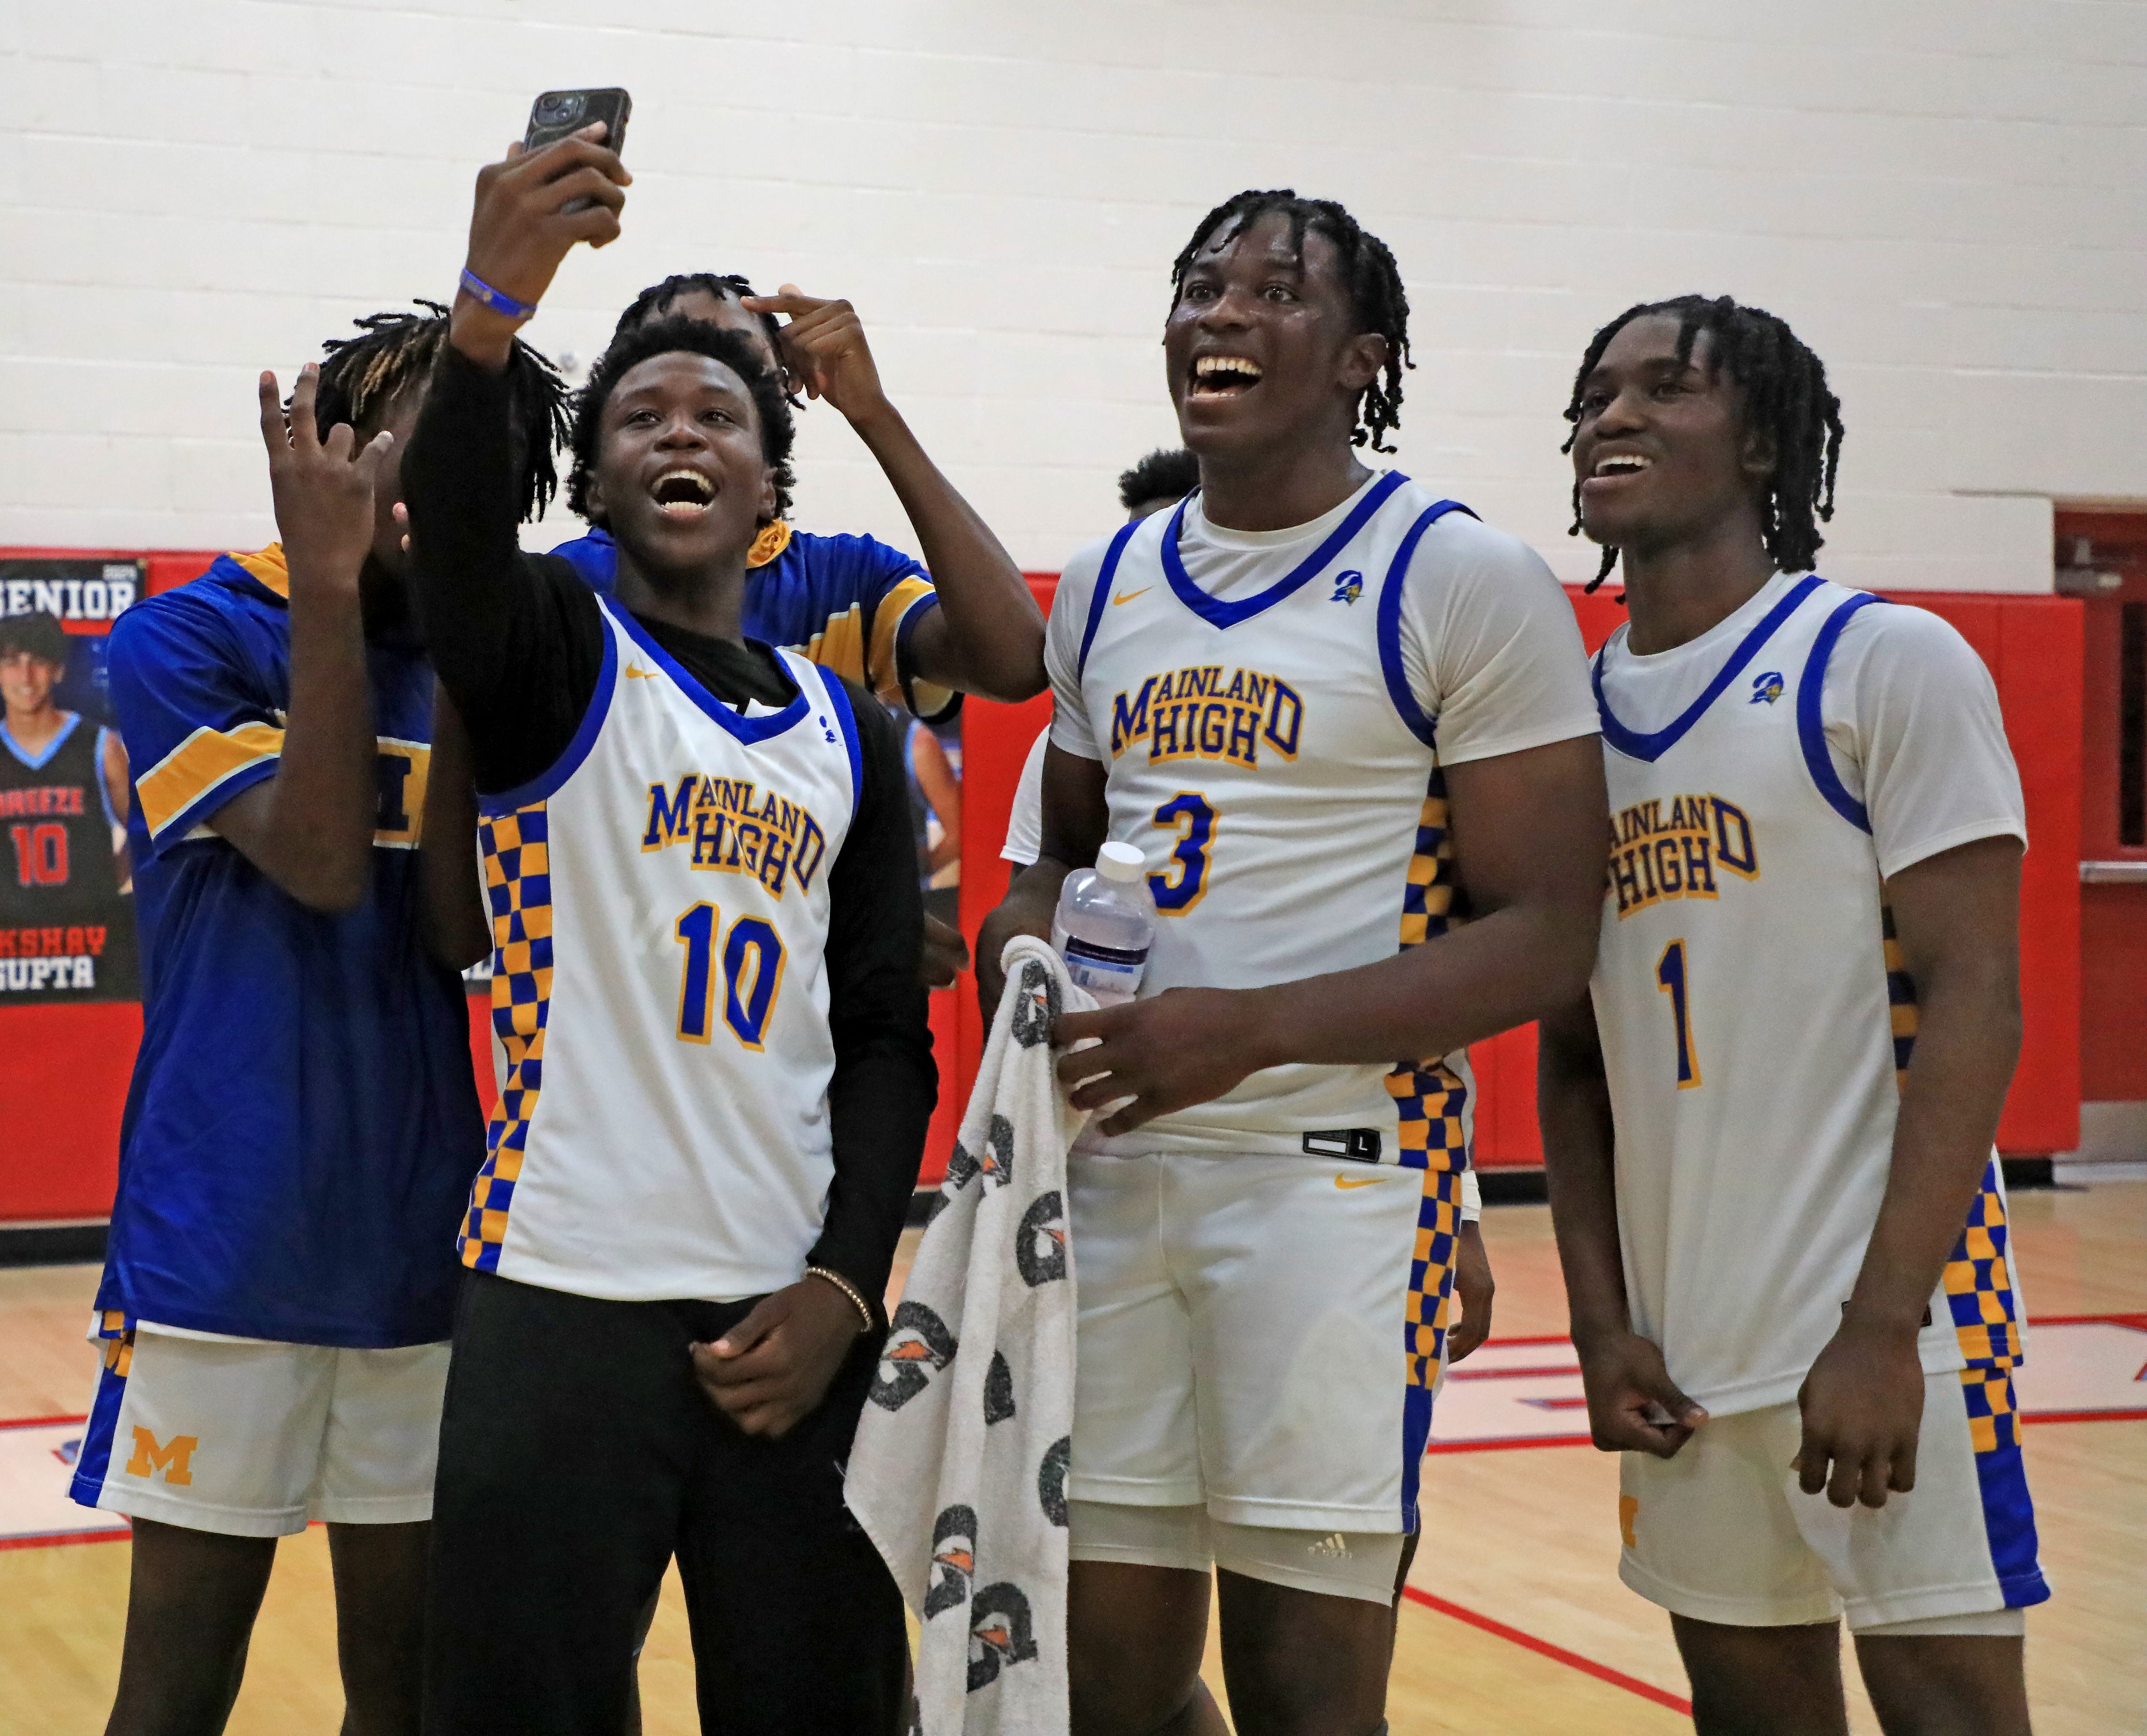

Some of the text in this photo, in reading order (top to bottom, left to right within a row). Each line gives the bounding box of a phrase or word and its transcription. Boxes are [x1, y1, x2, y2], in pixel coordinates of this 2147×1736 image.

[0, 579, 136, 620] ENIOR
[1110, 665, 1305, 763] MAINLAND
[1149, 703, 1261, 771] HIGH
[11, 823, 68, 885] 10
[641, 773, 826, 897] MAINLAND
[690, 810, 794, 902] HIGH
[1146, 790, 1222, 917] 3
[1607, 792, 1760, 882] AINLAND
[1608, 836, 1719, 921] HIGH
[0, 927, 107, 958] KSHAY
[0, 956, 95, 991] UPTA
[675, 900, 788, 1053] 10
[1655, 938, 1702, 1091] 1
[126, 1425, 198, 1486] M
